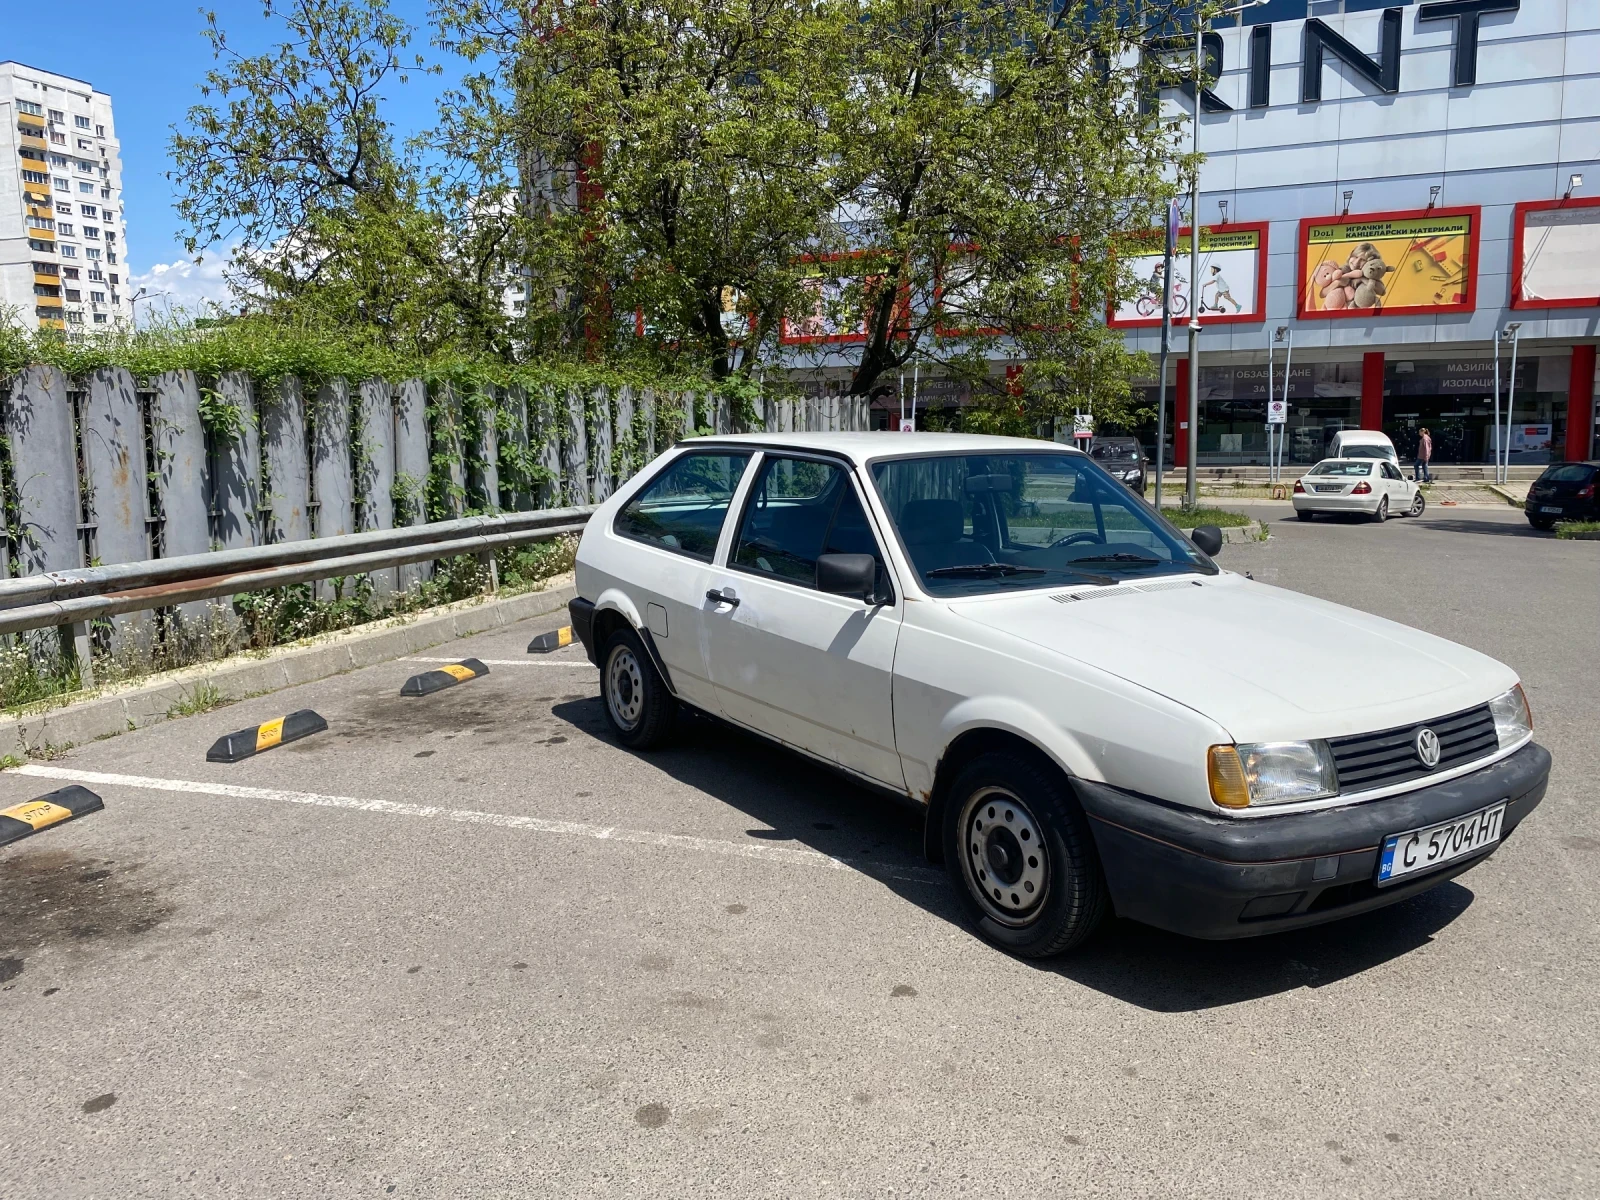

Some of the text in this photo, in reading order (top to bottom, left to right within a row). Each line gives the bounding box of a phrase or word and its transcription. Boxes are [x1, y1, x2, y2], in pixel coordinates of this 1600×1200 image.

[1345, 225, 1463, 239] КАНЦЕЛАРСКИ МАТЕРИАЛИ
[1346, 224, 1384, 232] ИГРАЧКИ
[1253, 384, 1266, 393] ЗА
[260, 727, 279, 740] STOP
[23, 804, 52, 821] STOP
[1381, 861, 1392, 873] BG
